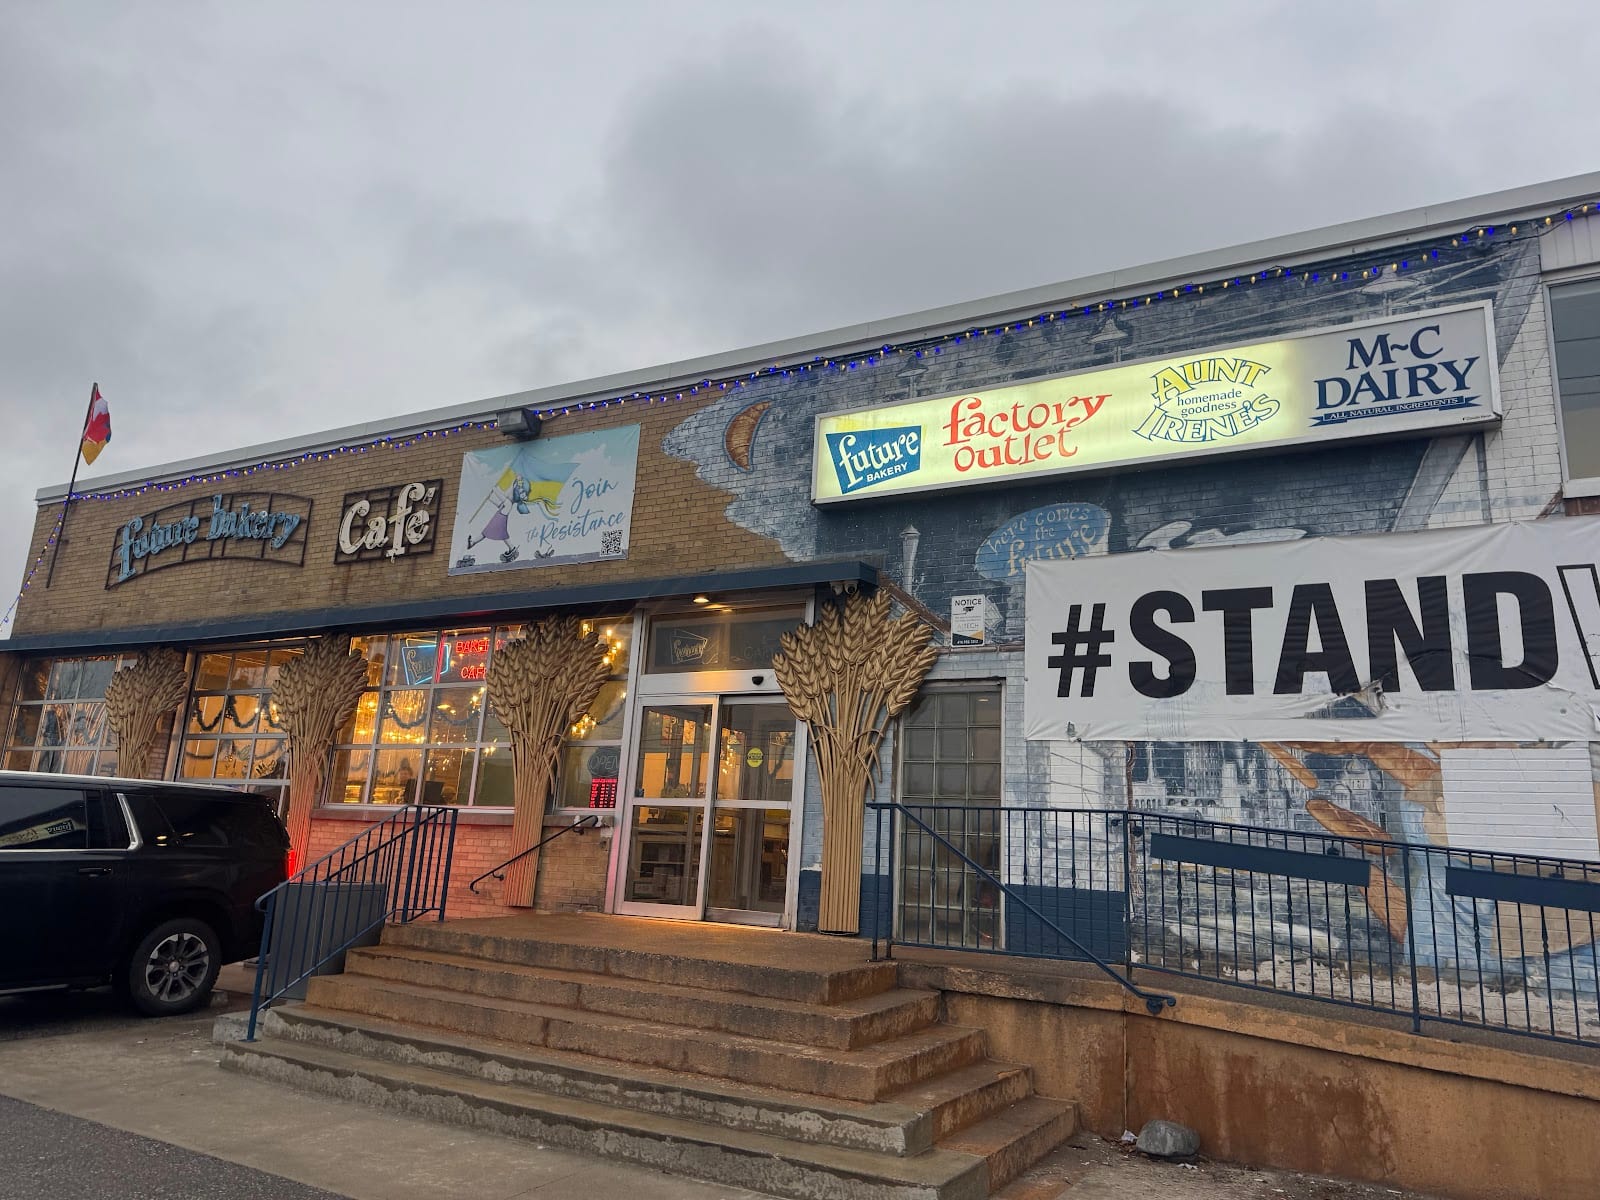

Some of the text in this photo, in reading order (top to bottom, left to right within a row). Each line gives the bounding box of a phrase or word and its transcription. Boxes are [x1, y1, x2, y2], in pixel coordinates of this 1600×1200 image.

[1150, 357, 1272, 407] AUNT
[1177, 388, 1242, 406] homemade
[1313, 356, 1481, 410] DAIRY
[943, 396, 1113, 447] factory
[1181, 400, 1237, 417] goodness
[1329, 397, 1459, 420] ALL NATURAL INGREDIENTS
[839, 431, 919, 489] future
[866, 462, 908, 482] BAKERY
[954, 426, 1079, 472] outlet
[571, 477, 618, 514] Join
[1036, 507, 1090, 526] comes
[117, 493, 300, 582] future bakery
[338, 482, 436, 564] Café
[539, 508, 624, 547] Resistance
[1048, 564, 1600, 698] #STAND
